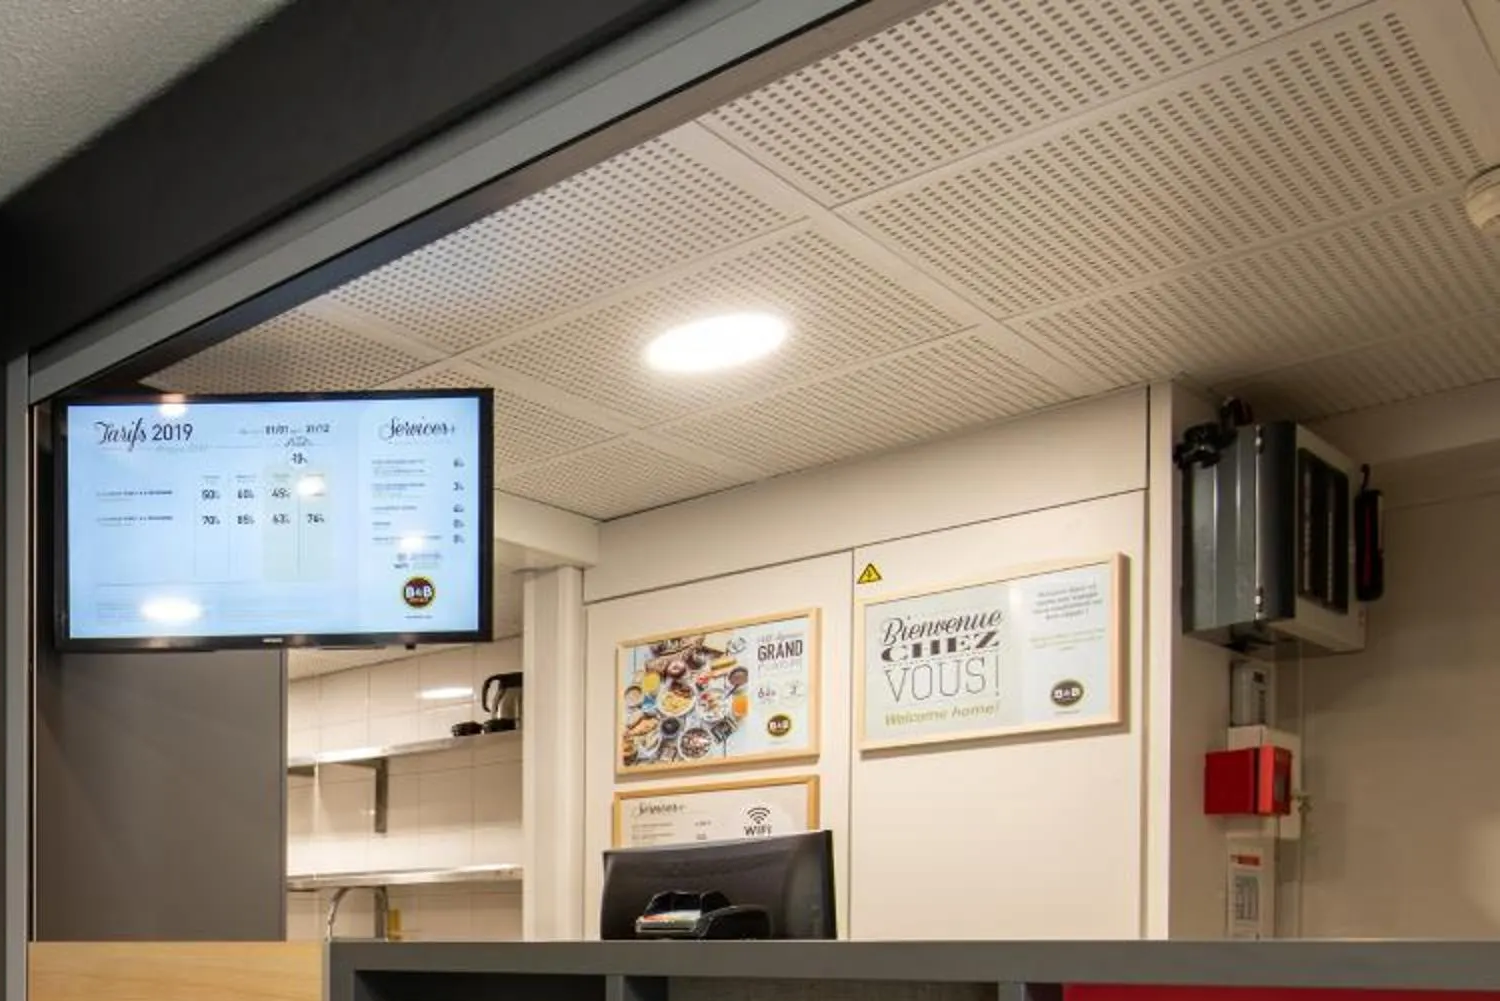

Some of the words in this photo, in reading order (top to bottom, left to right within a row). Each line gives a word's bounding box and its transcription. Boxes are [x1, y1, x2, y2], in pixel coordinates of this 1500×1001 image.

[94, 417, 147, 451] Tarifs
[151, 423, 193, 441] 2019
[882, 609, 1002, 645] Bienvenue
[757, 640, 803, 662] GRAND
[881, 630, 1000, 663] CHEZ
